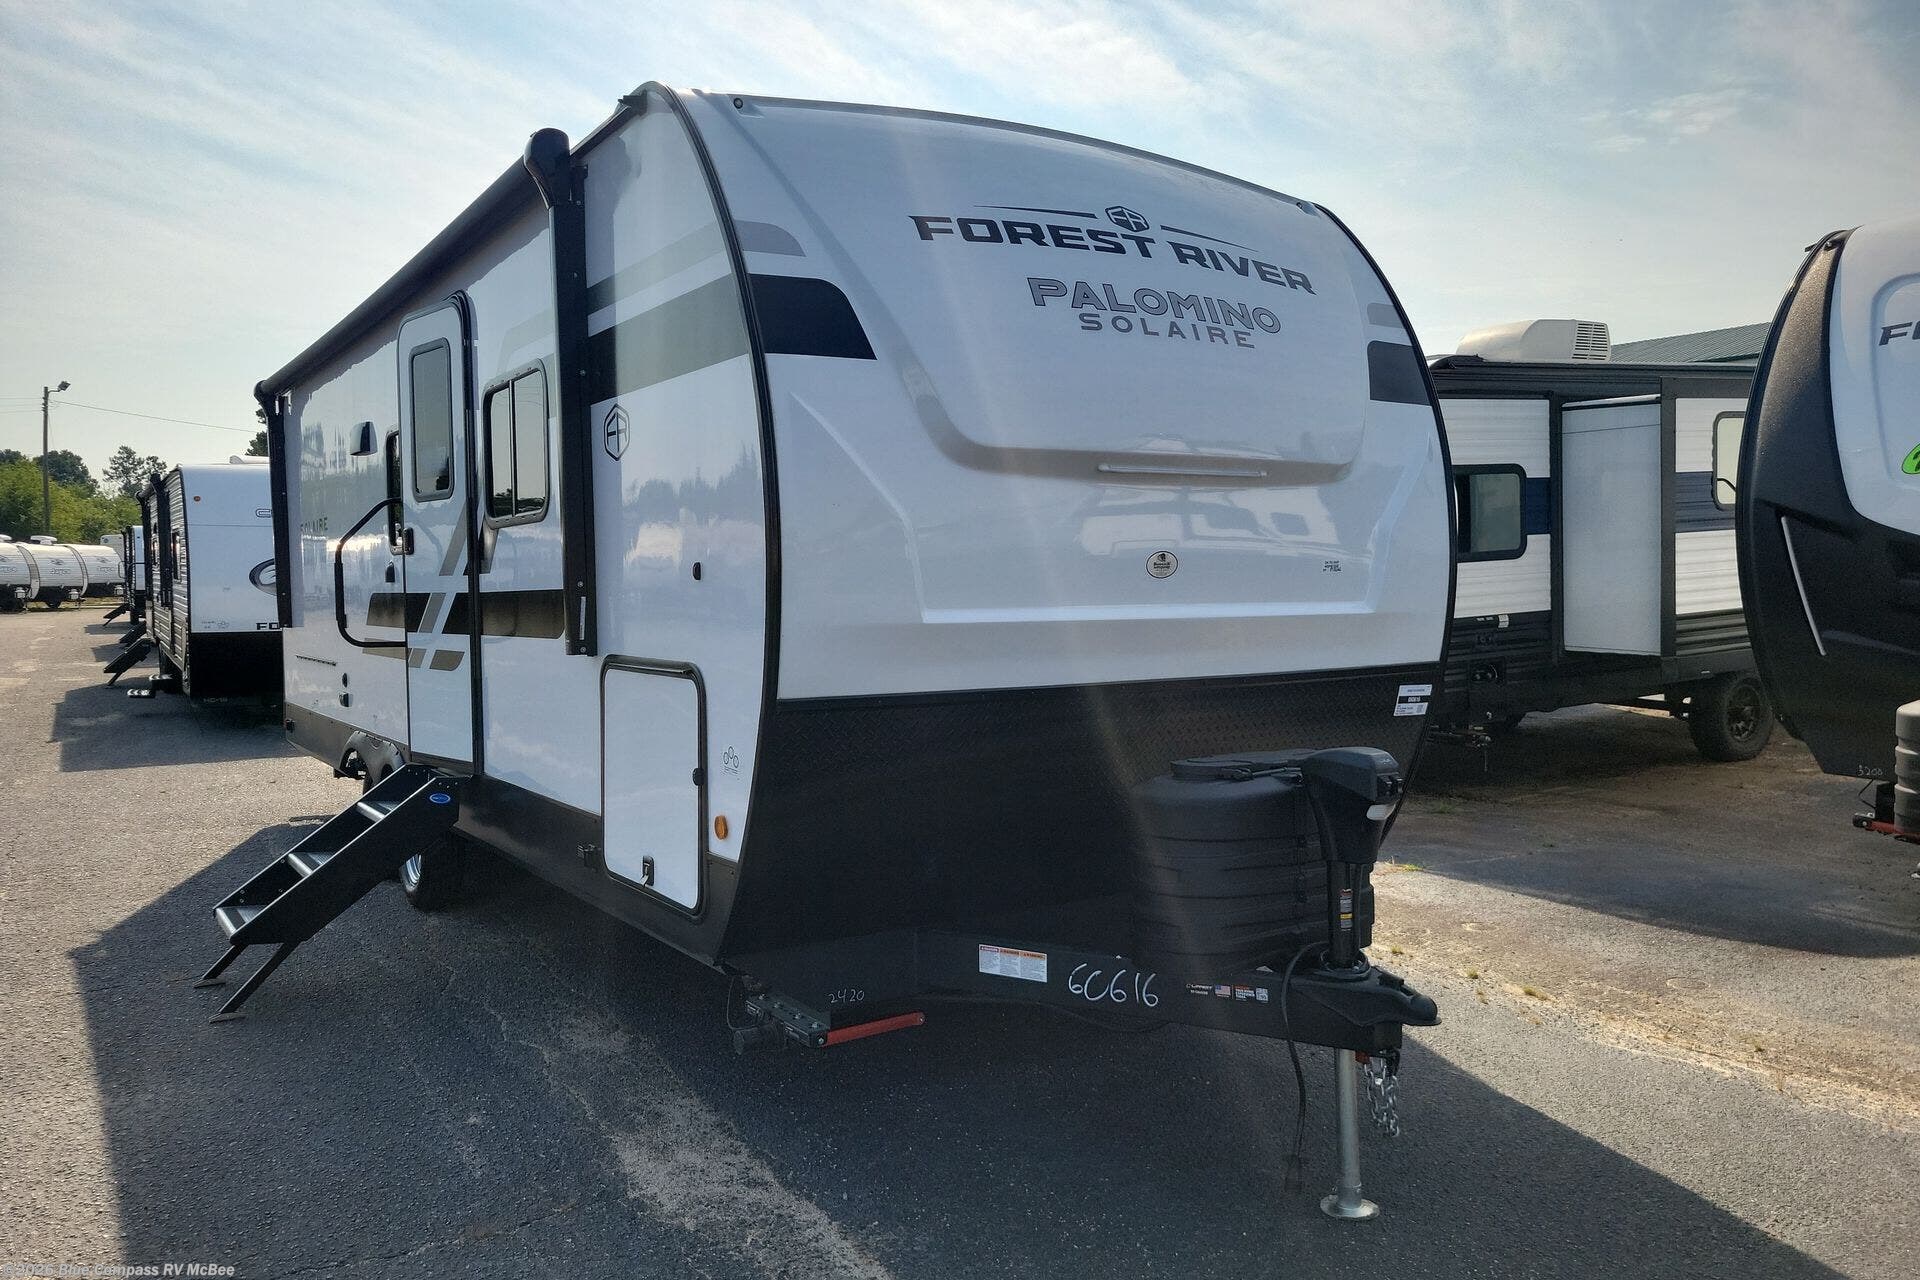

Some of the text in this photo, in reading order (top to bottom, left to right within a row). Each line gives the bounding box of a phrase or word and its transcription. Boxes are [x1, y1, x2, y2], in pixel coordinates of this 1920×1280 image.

[908, 215, 1318, 295] FOREST RIVER
[1027, 277, 1282, 334] PALOMINO
[1081, 313, 1256, 349] SOLAIRE
[828, 988, 865, 1003] 2420
